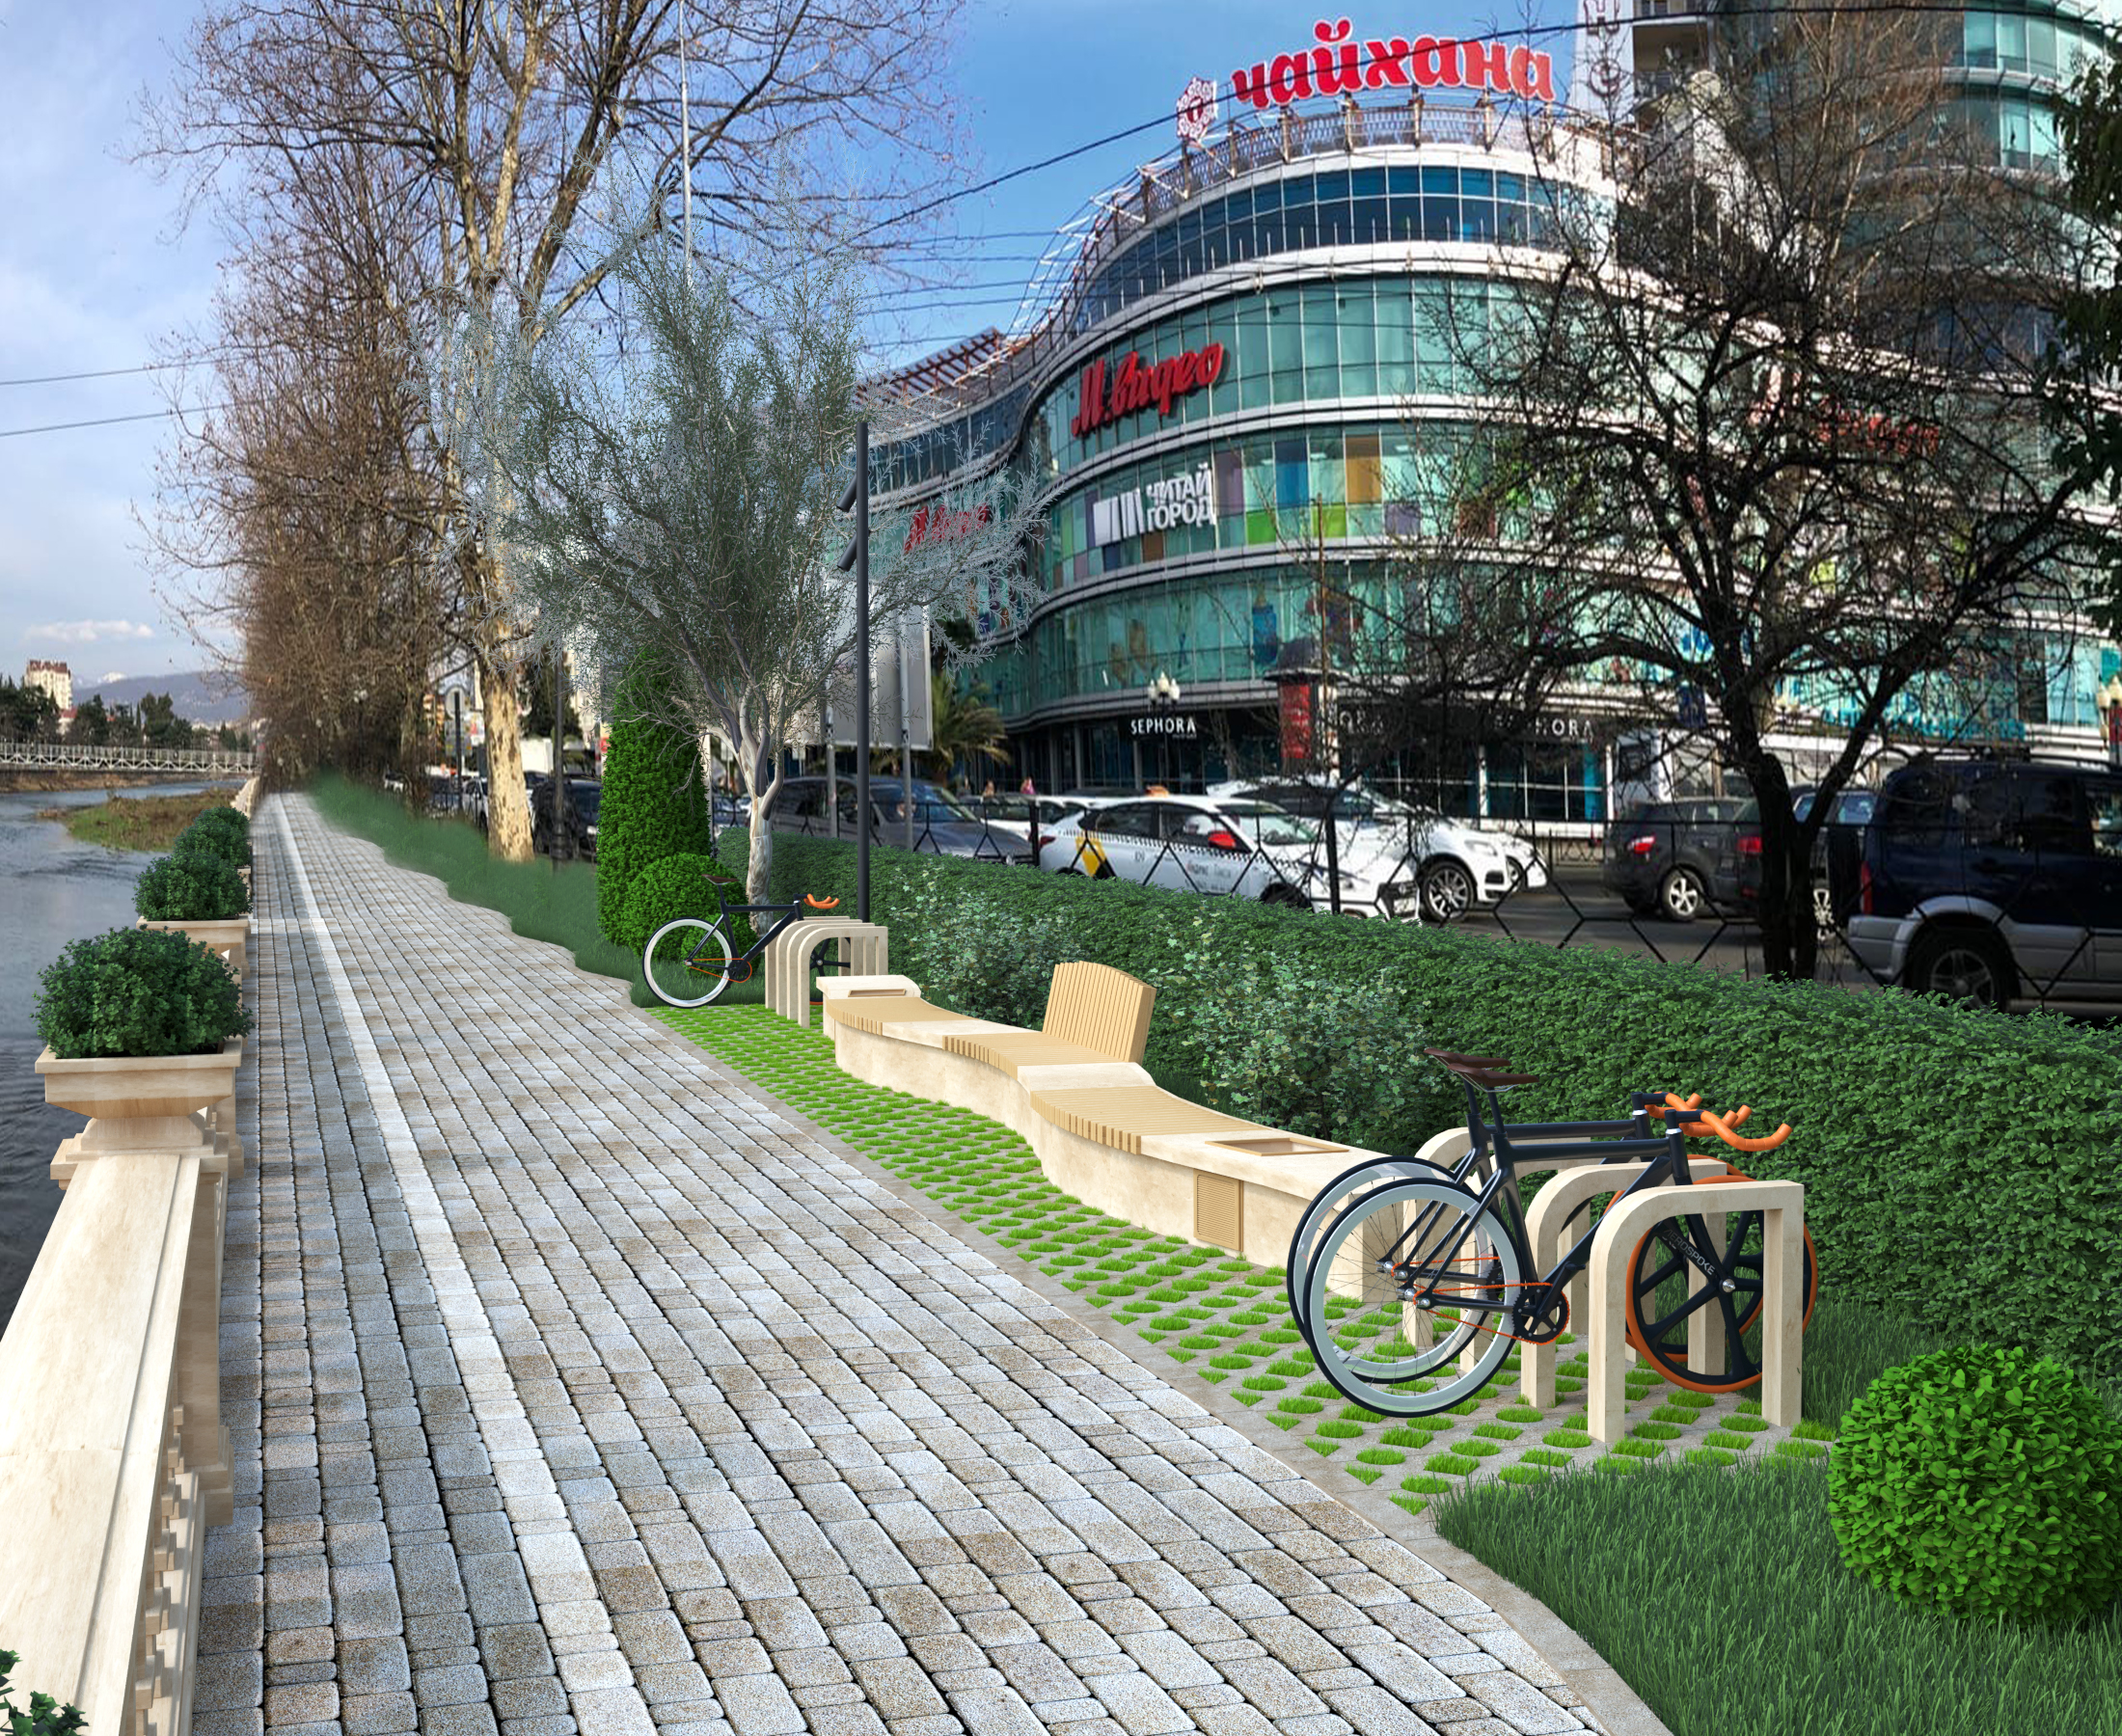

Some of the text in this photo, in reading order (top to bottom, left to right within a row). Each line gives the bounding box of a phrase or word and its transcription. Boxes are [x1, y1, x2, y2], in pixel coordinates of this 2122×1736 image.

[1146, 463, 1213, 505] ЧИТАЙ
[1147, 496, 1215, 531] ГОРОД
[1130, 717, 1196, 735] SEPHORA
[1663, 1229, 1716, 1276] AEROSPOKE
